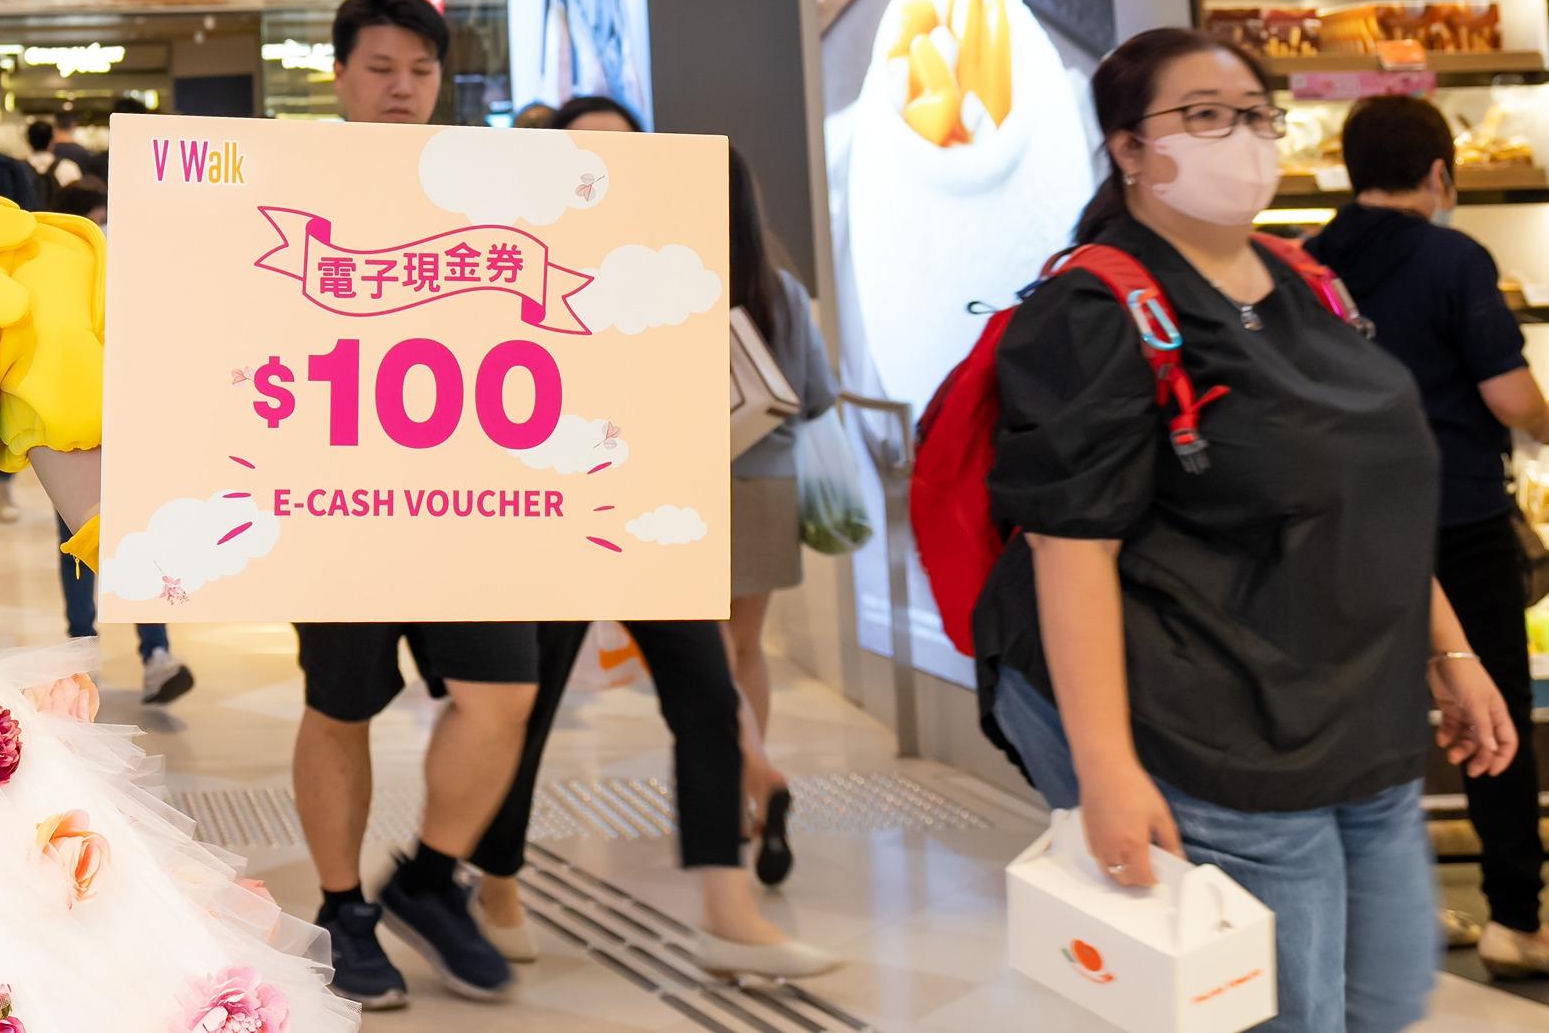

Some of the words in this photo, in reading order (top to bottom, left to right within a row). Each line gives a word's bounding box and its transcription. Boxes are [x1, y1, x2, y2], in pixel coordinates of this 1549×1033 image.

[152, 138, 170, 183] V
[179, 139, 246, 185] Walk
[317, 241, 525, 299] 電子現金券
[252, 337, 564, 451] $100
[273, 487, 396, 519] E-CASH
[403, 488, 566, 520] VOUCHER
